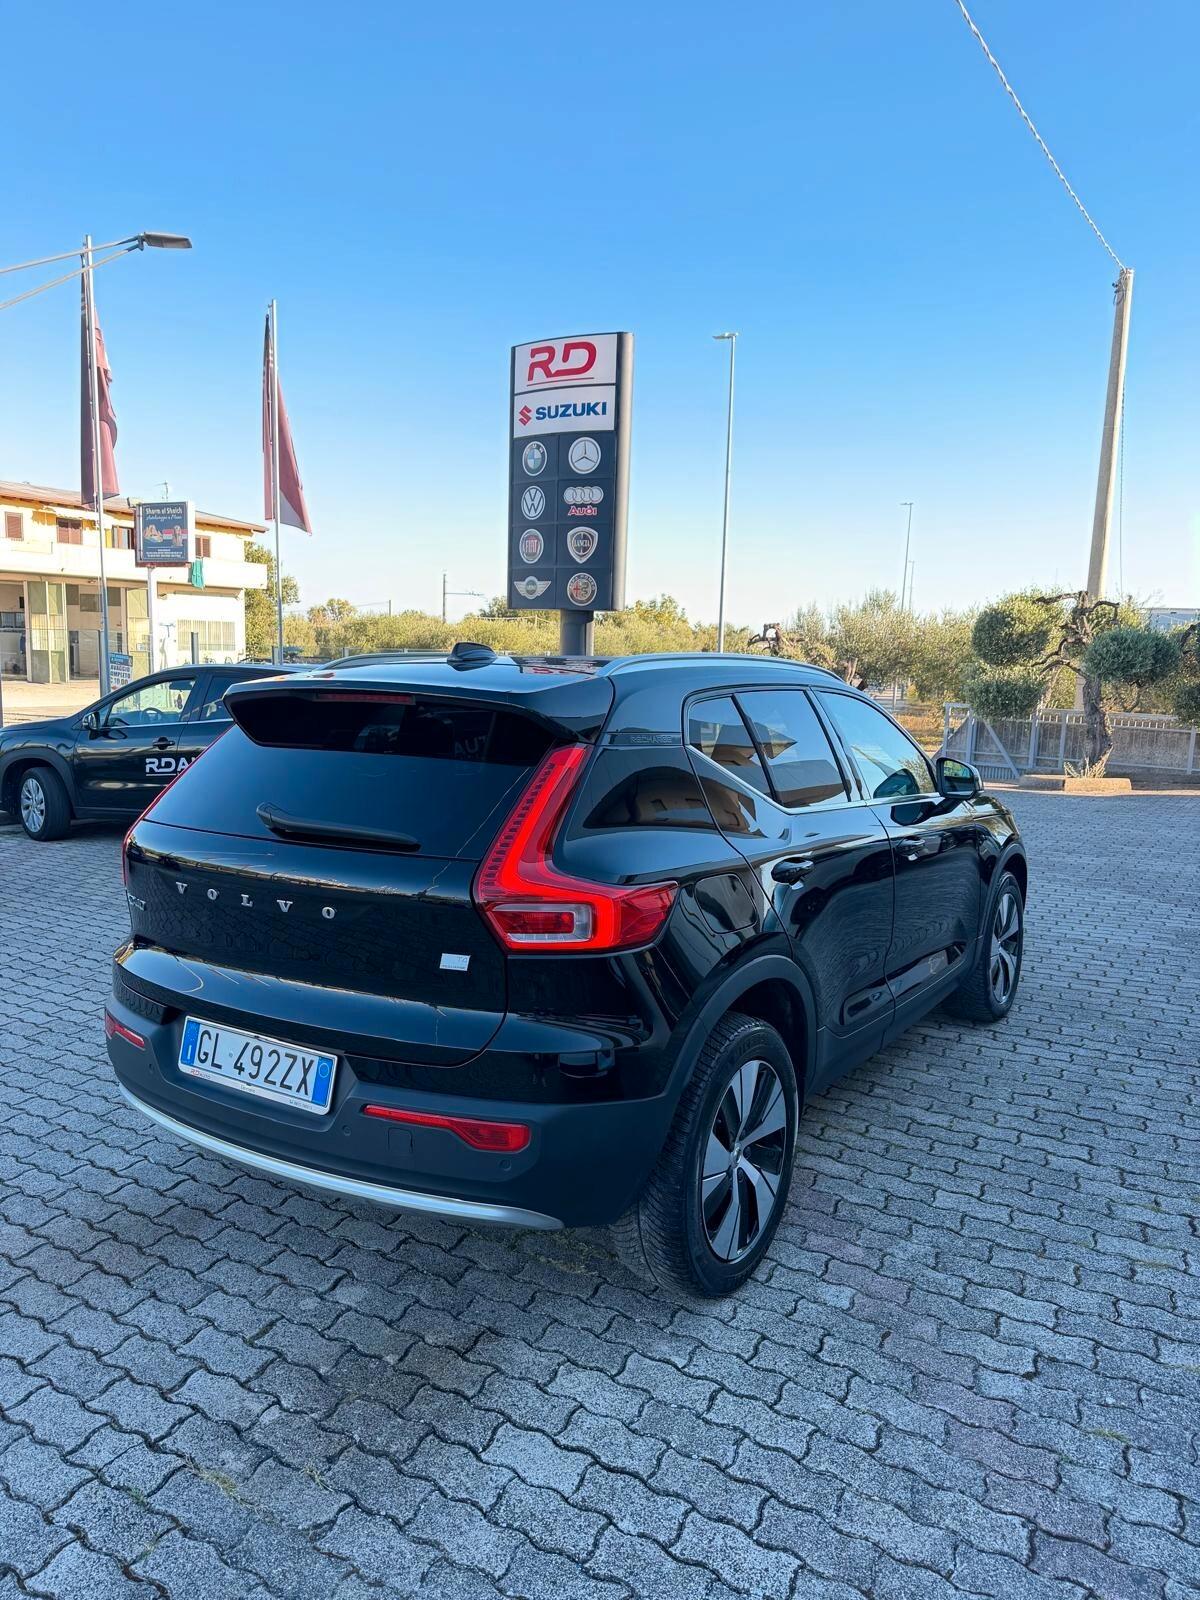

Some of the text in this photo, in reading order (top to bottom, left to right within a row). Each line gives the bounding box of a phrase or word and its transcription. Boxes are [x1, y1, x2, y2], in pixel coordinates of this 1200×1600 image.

[527, 341, 597, 381] RD
[535, 401, 607, 420] SUZUKI
[567, 505, 597, 516] Audi
[525, 539, 538, 553] FIAT
[175, 881, 338, 920] VOLVO
[197, 1029, 222, 1070] GL
[233, 1041, 315, 1096] 492ZX
